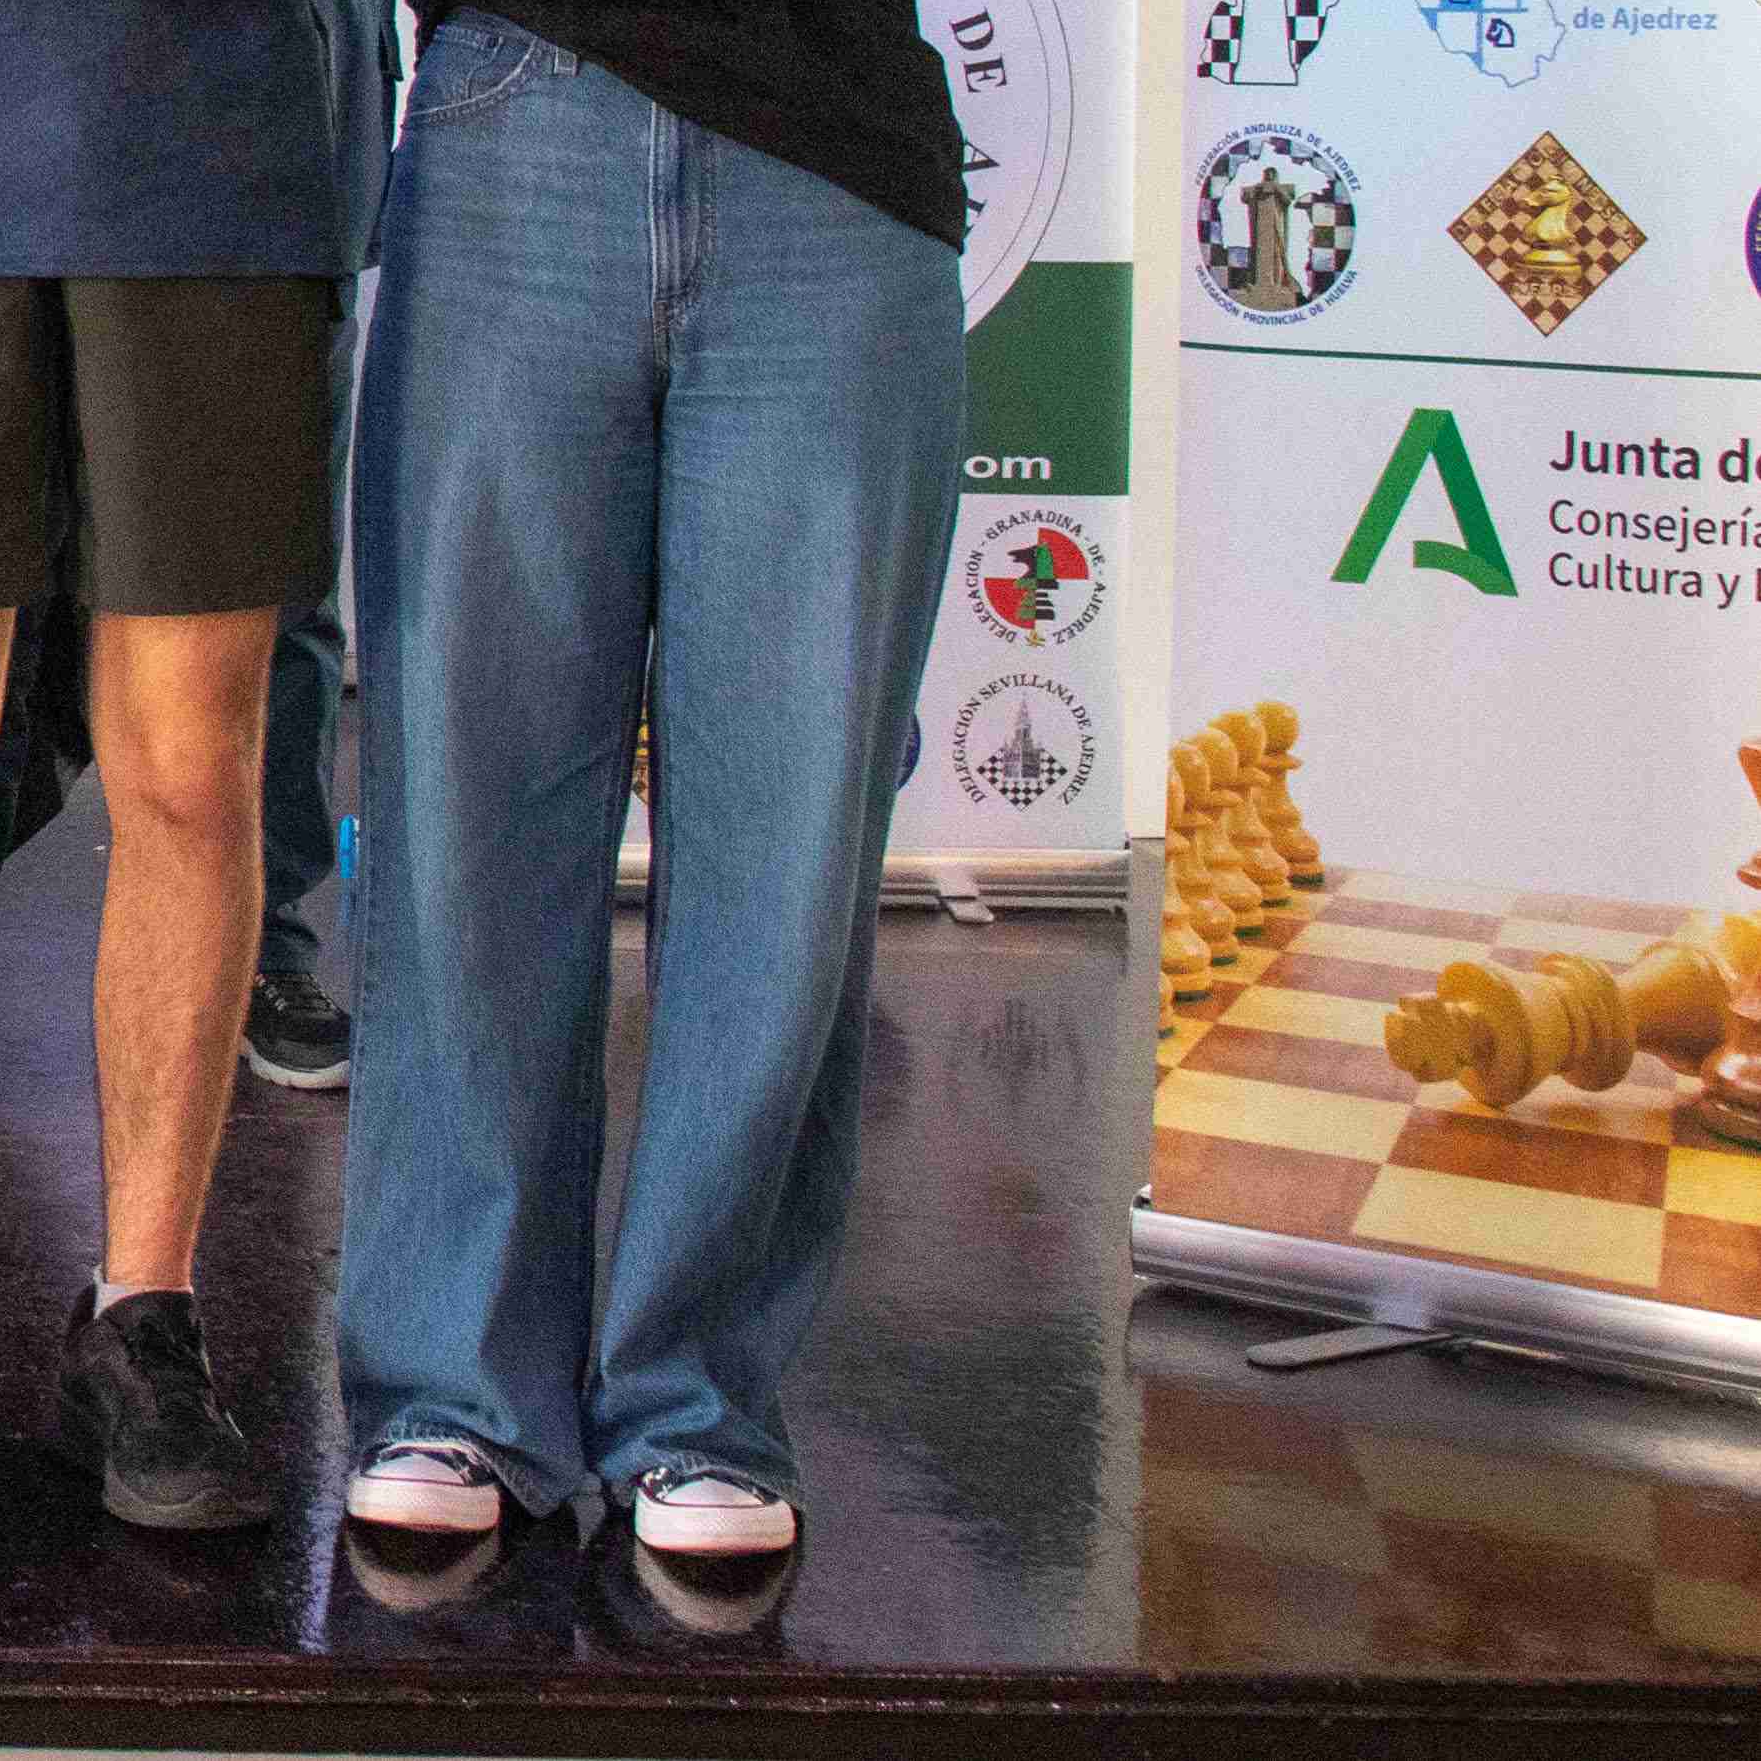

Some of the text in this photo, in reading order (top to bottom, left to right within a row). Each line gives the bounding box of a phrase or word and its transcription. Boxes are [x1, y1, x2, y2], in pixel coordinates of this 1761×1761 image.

[1572, 6, 1718, 35] de Ajedrez
[1243, 123, 1302, 139] ANDALUZA
[1307, 133, 1322, 148] DE
[1323, 144, 1362, 193] AJEDREZ
[1243, 310, 1307, 326] PROVINCIAL
[1326, 269, 1358, 306] HUELVA
[1549, 429, 1701, 480] Junta
[986, 509, 1084, 541] GRANADINA
[1052, 581, 1106, 645] AJEDREZ
[1548, 552, 1703, 598] Cultura
[1716, 571, 1742, 610] y
[979, 673, 1075, 706] SEVILLANA
[1071, 705, 1092, 731] DE
[1061, 734, 1094, 806] AJEDREZ
